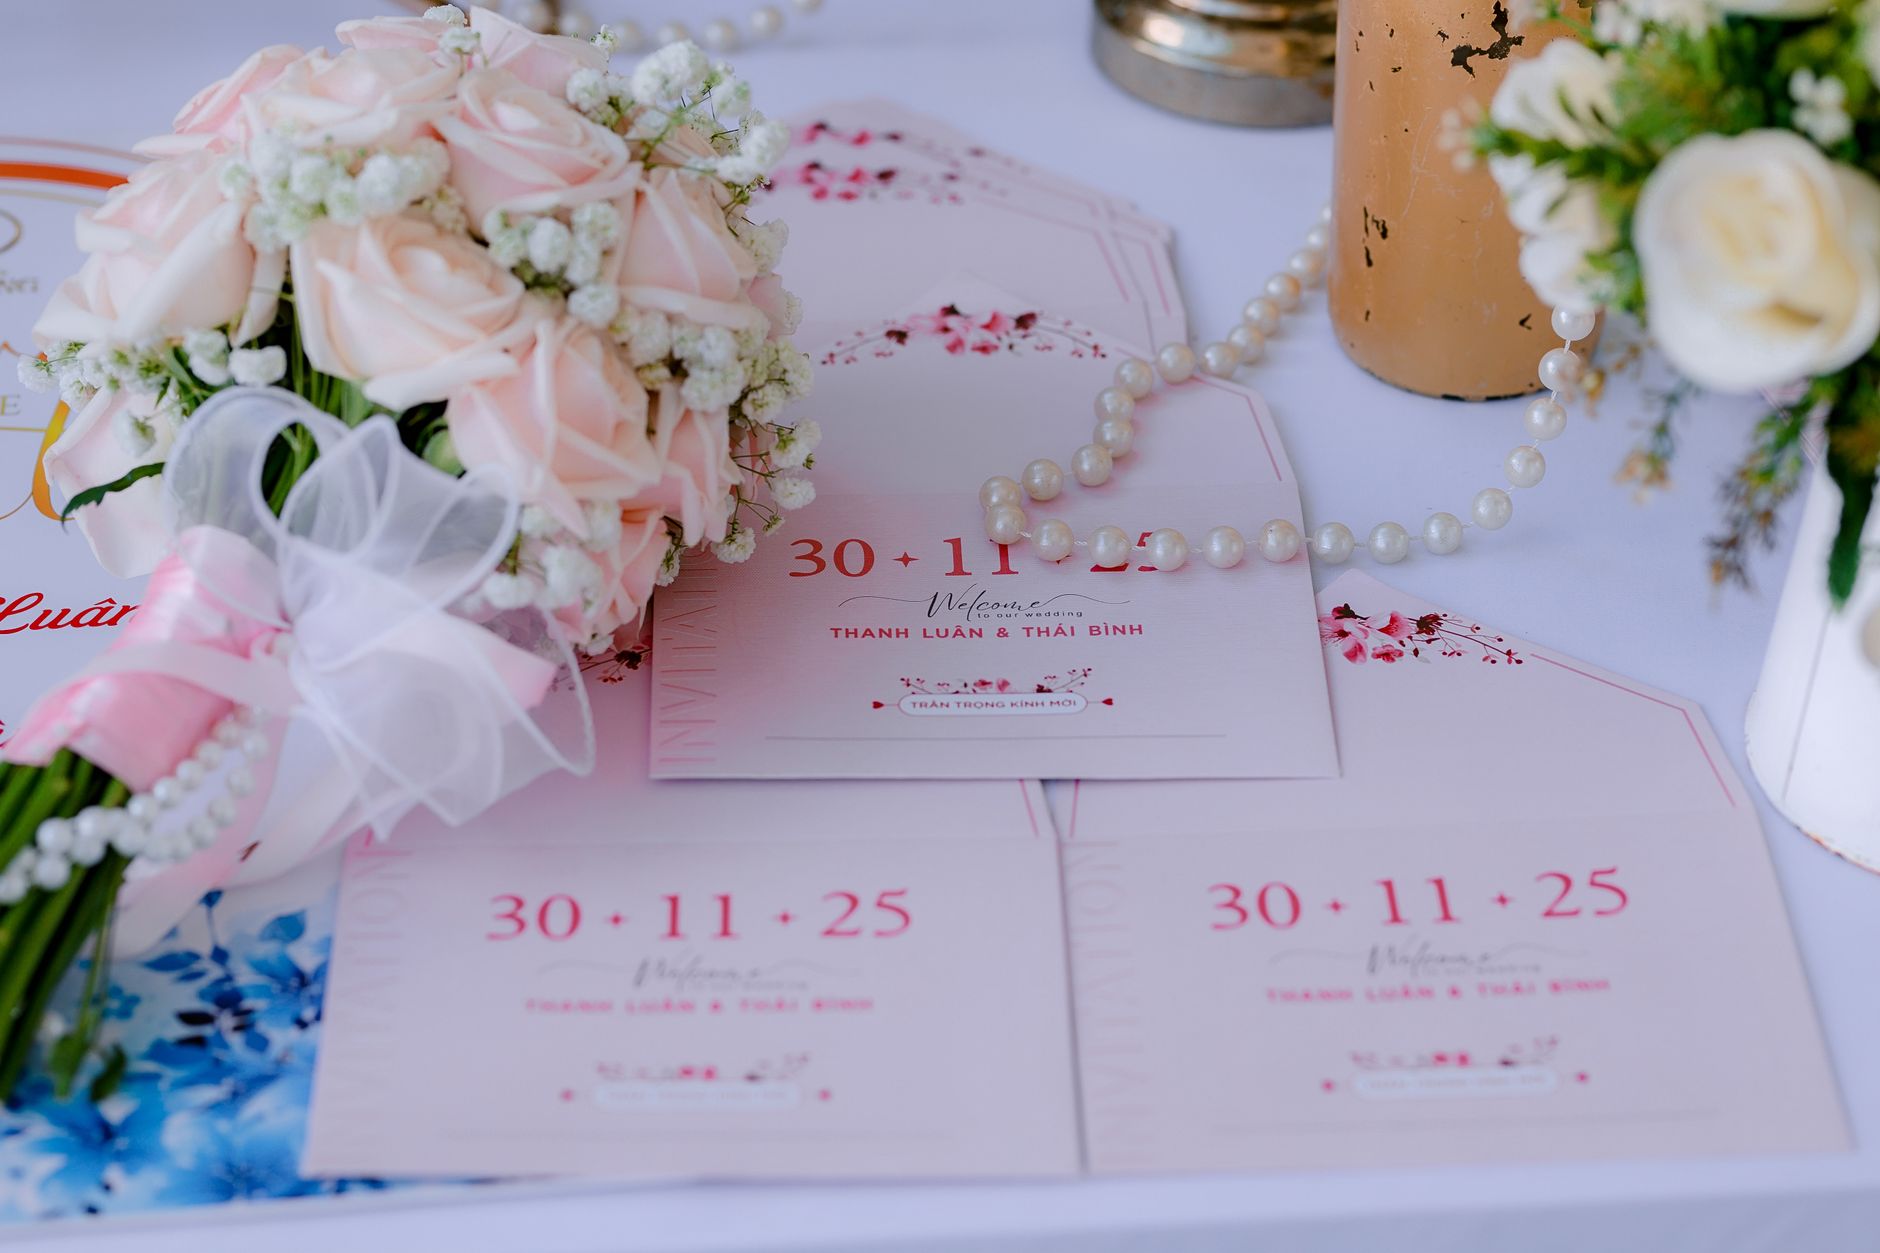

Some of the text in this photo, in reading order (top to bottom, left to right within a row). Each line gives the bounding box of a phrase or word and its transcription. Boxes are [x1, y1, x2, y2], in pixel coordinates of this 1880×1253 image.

[788, 537, 875, 578] 30
[926, 583, 1042, 622] Welcome
[1025, 610, 1084, 619] wedding
[829, 622, 1144, 639] THANH LUÂN & THÁI BÌNH
[486, 889, 913, 941] 30 11 25
[1209, 866, 1630, 931] 30 11 25
